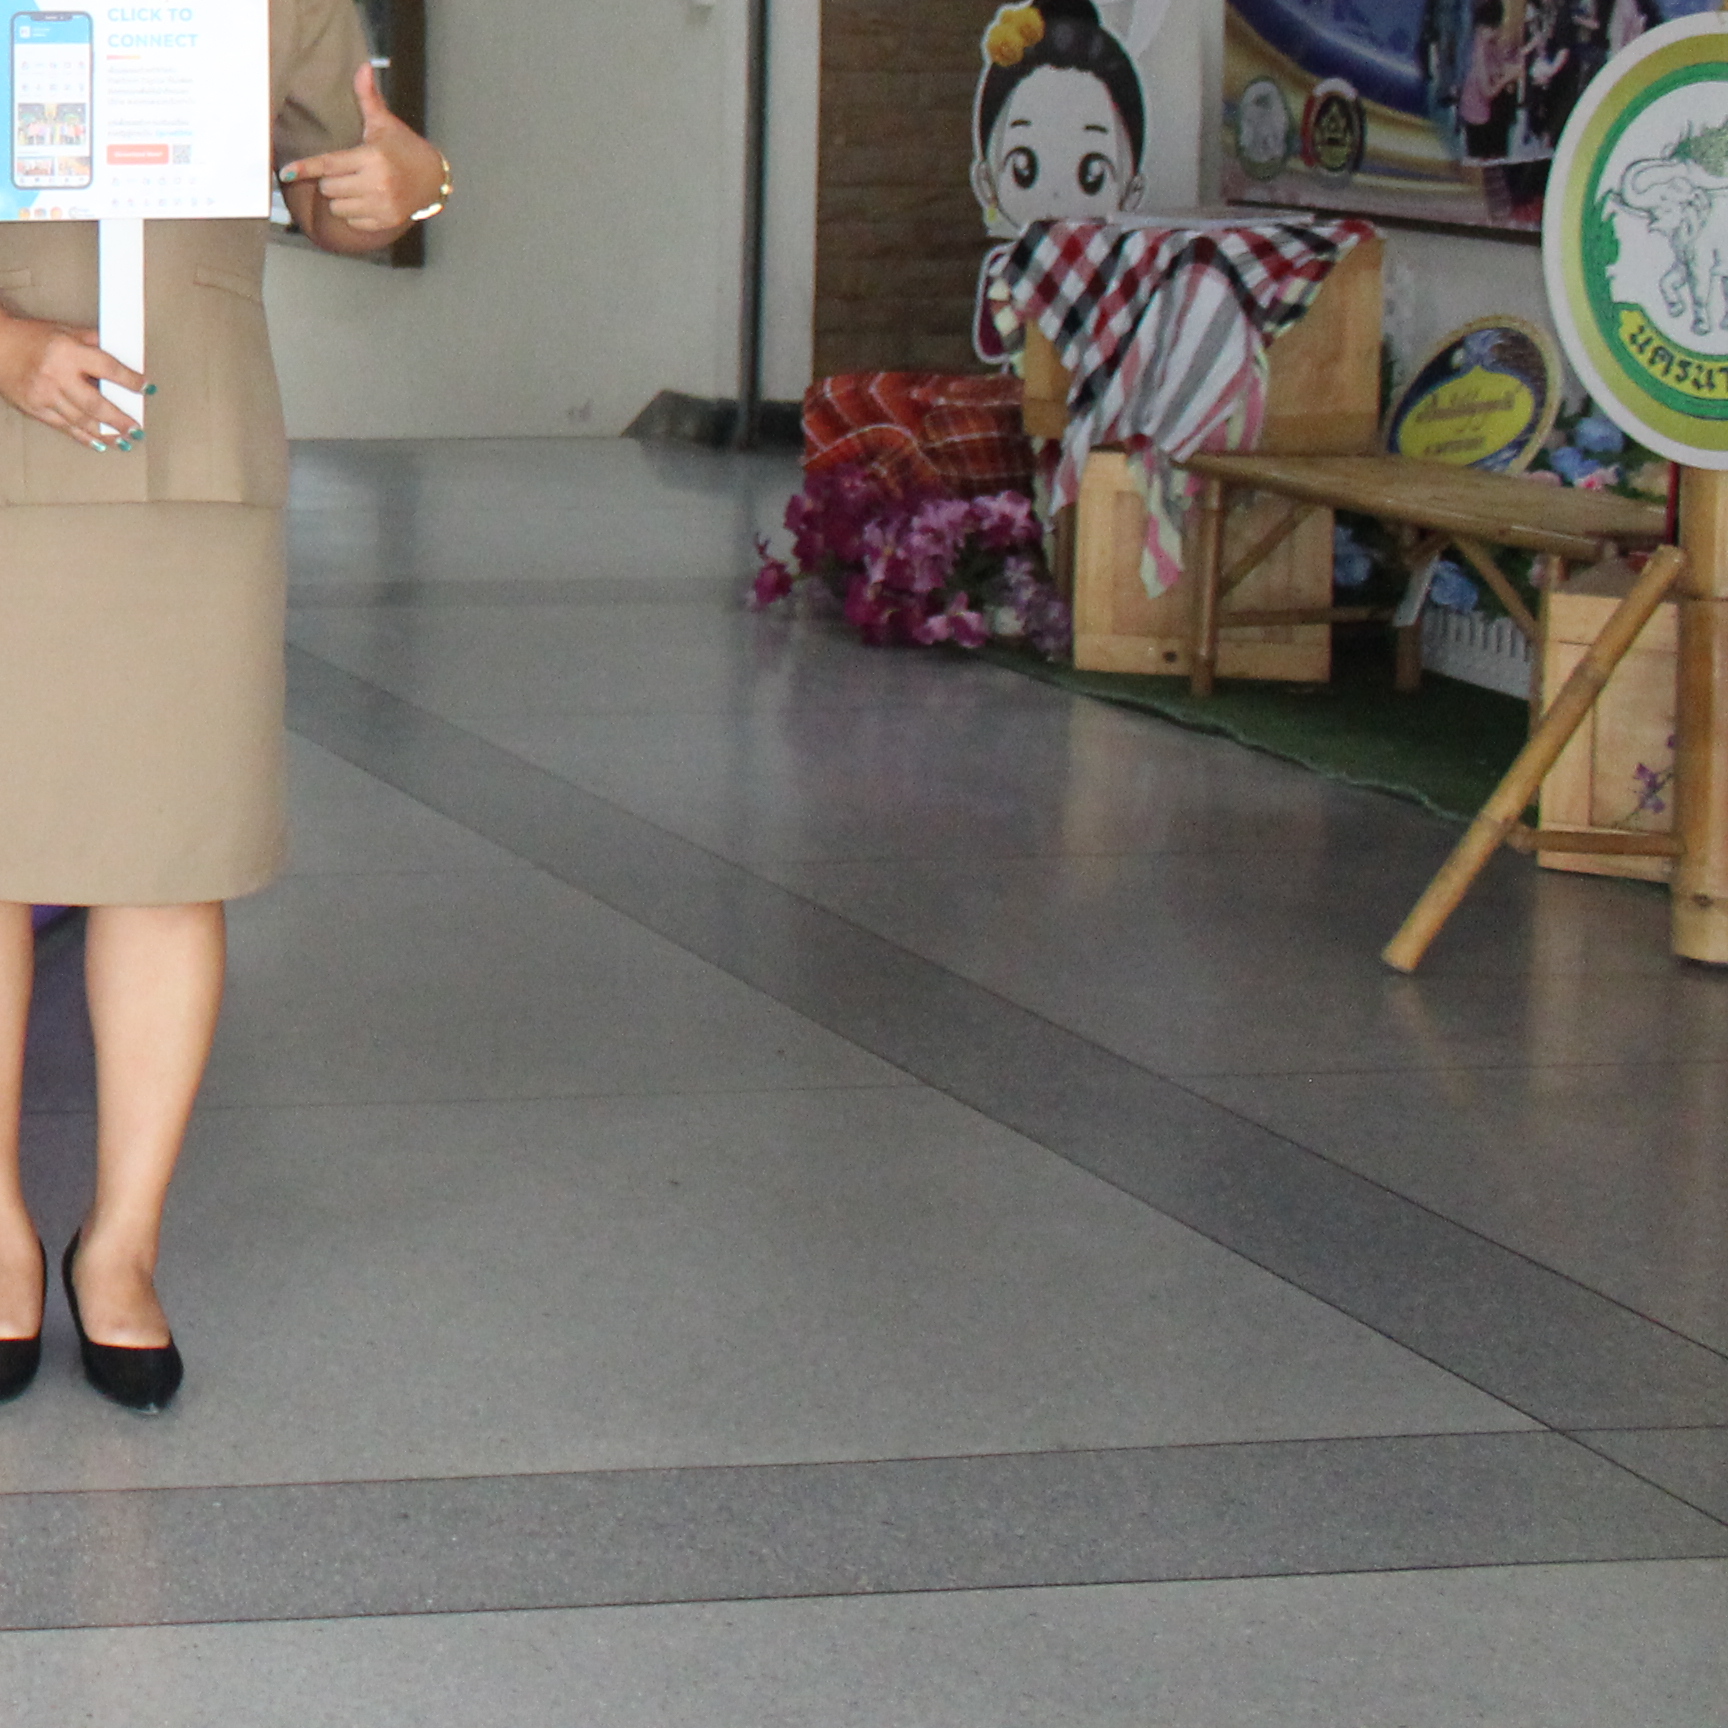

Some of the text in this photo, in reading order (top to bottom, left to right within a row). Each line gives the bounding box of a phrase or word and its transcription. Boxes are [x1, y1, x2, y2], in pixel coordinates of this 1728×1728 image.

[107, 8, 193, 22] CLICK TO
[107, 34, 199, 48] CONNECT
